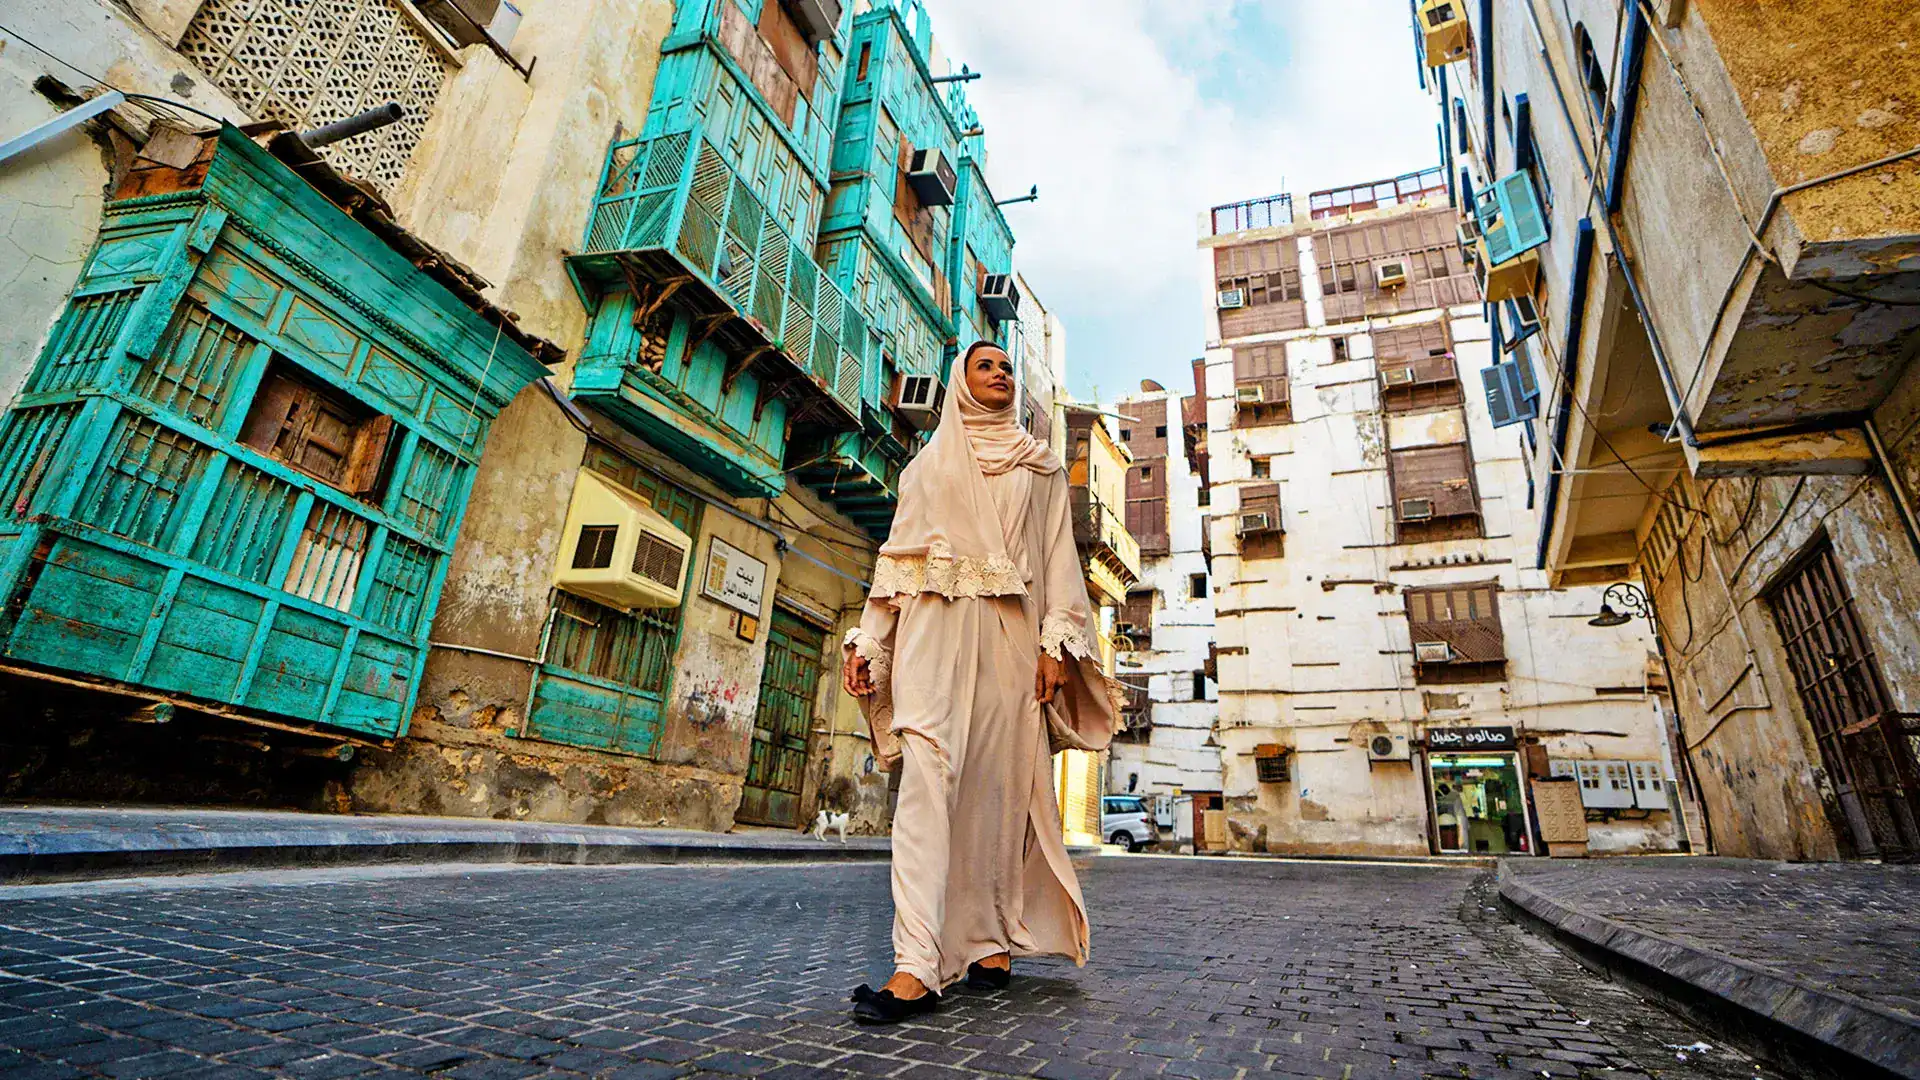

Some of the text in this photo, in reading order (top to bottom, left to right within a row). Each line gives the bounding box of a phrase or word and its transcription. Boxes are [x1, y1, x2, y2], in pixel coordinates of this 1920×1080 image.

[736, 566, 755, 587] بيت
[1431, 729, 1506, 744] صالون جميل
